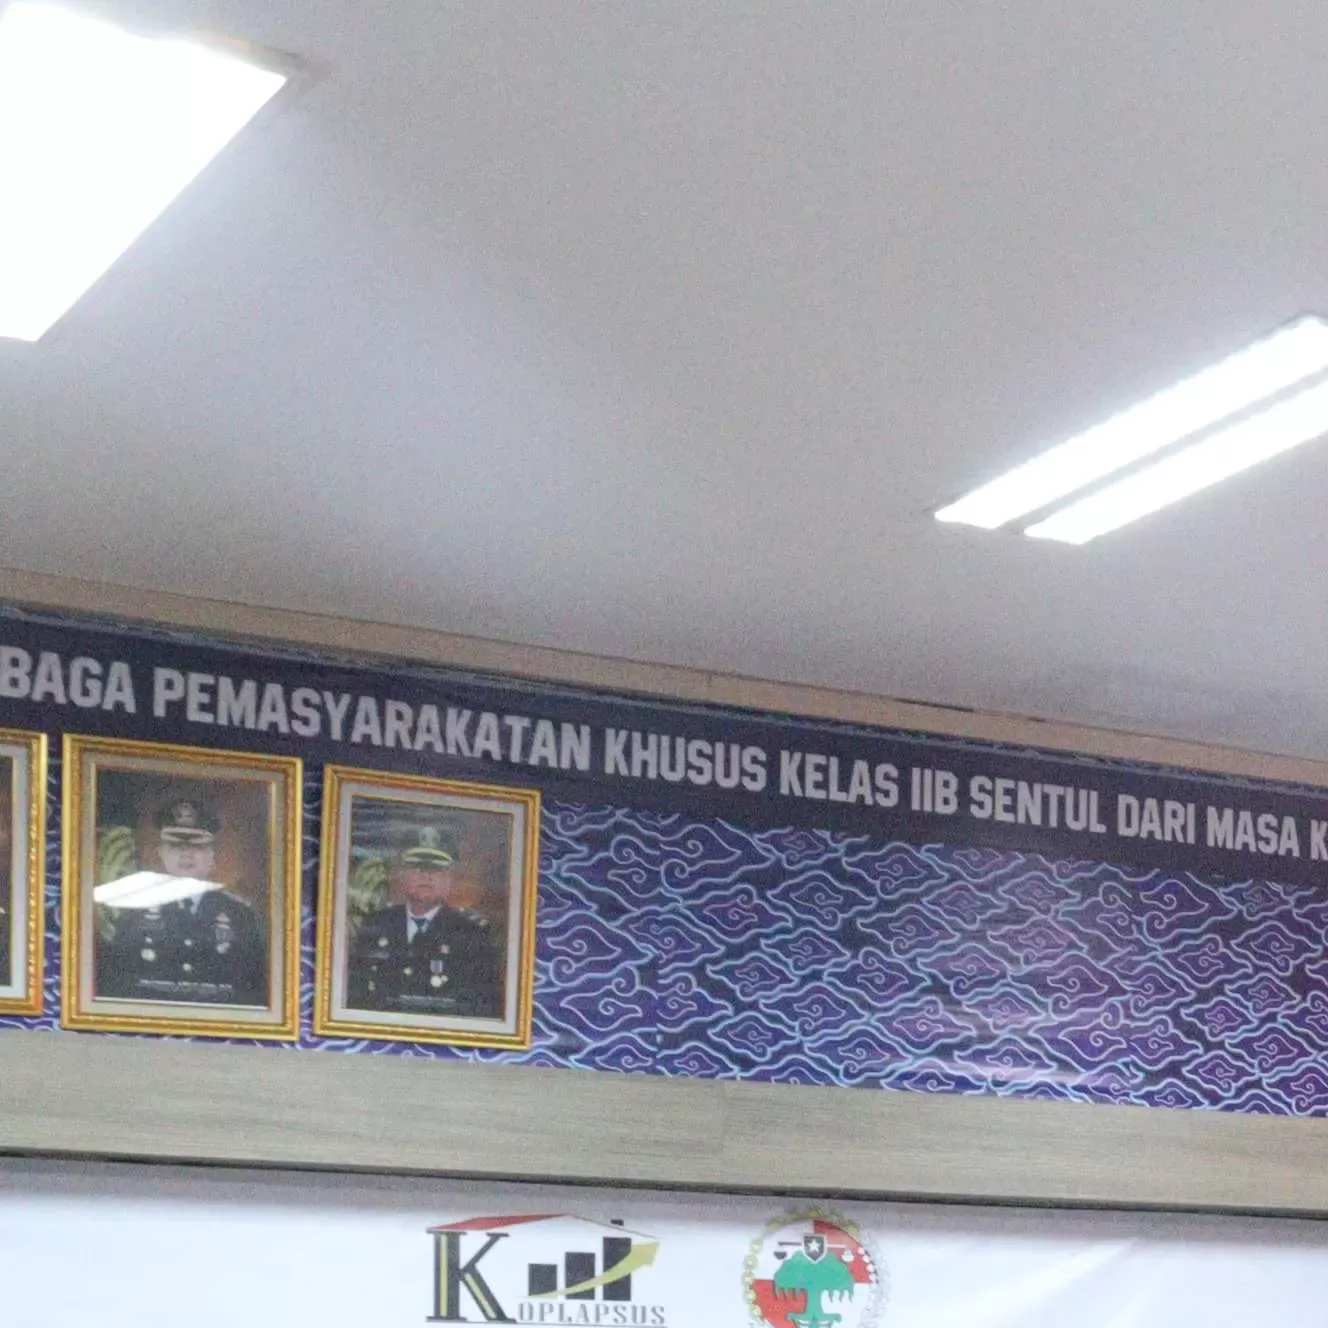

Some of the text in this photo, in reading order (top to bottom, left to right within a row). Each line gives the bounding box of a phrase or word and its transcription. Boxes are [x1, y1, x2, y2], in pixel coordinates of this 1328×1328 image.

[0, 645, 137, 714] BAGA
[153, 666, 592, 772] PEMASYARAKATAN
[604, 727, 768, 793] KHUSUS
[779, 749, 899, 809] KELAS
[910, 766, 958, 816] IIB
[969, 774, 1107, 835] SENTUL
[1117, 793, 1196, 846] DARI
[1206, 805, 1300, 859] MASA
